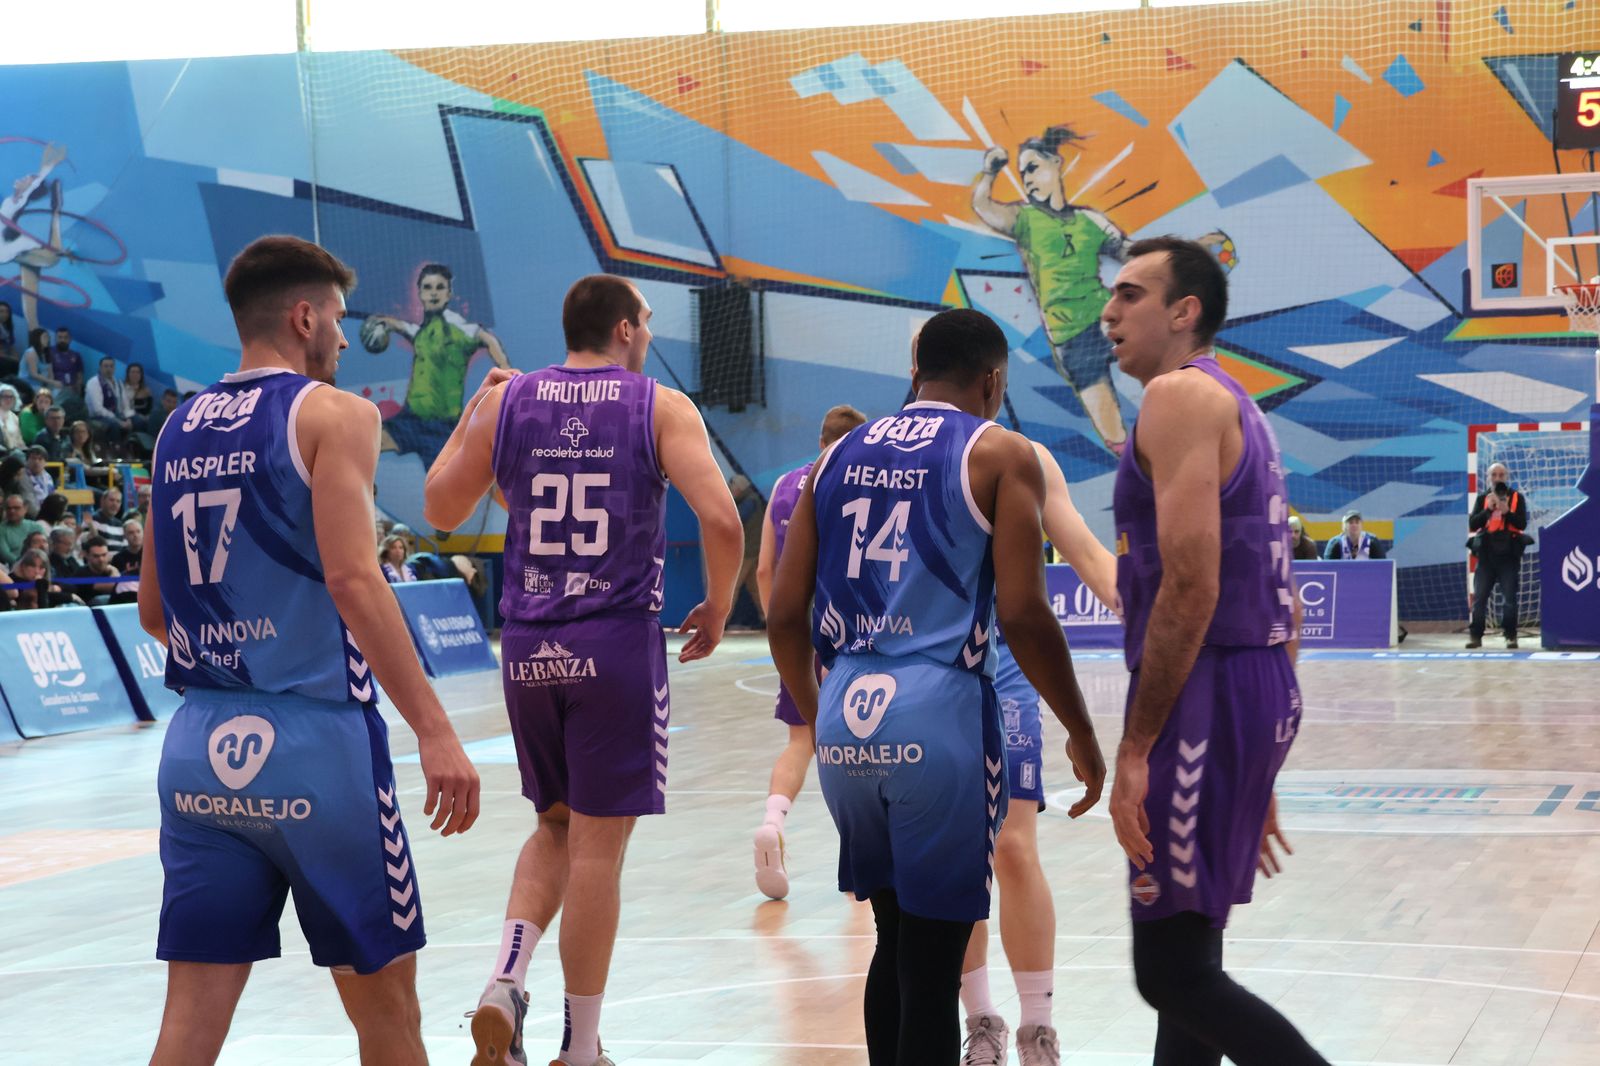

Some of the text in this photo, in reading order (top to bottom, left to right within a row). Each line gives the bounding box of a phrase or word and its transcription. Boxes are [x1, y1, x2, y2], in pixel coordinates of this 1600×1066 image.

[1577, 91, 1600, 127] 5
[536, 379, 622, 404] KRUTWIG
[182, 387, 262, 432] gaza
[863, 415, 945, 445] gaza
[531, 446, 615, 459] recoletas salud
[164, 450, 256, 484] NASPLER
[843, 464, 928, 490] HEARST
[529, 472, 612, 557] 25
[171, 487, 242, 586] 17
[841, 497, 912, 582] 14
[589, 579, 611, 592] Dip
[1300, 581, 1325, 606] C
[1052, 593, 1067, 616] a
[1302, 608, 1325, 618] ELS
[200, 616, 278, 646] INNOVA
[1302, 627, 1323, 637] OTT
[16, 631, 83, 689] gaza
[509, 658, 598, 681] LEBANZA
[1006, 732, 1035, 748] ORA
[819, 743, 923, 766] MORALEJO
[174, 792, 312, 820] MORALEJO
